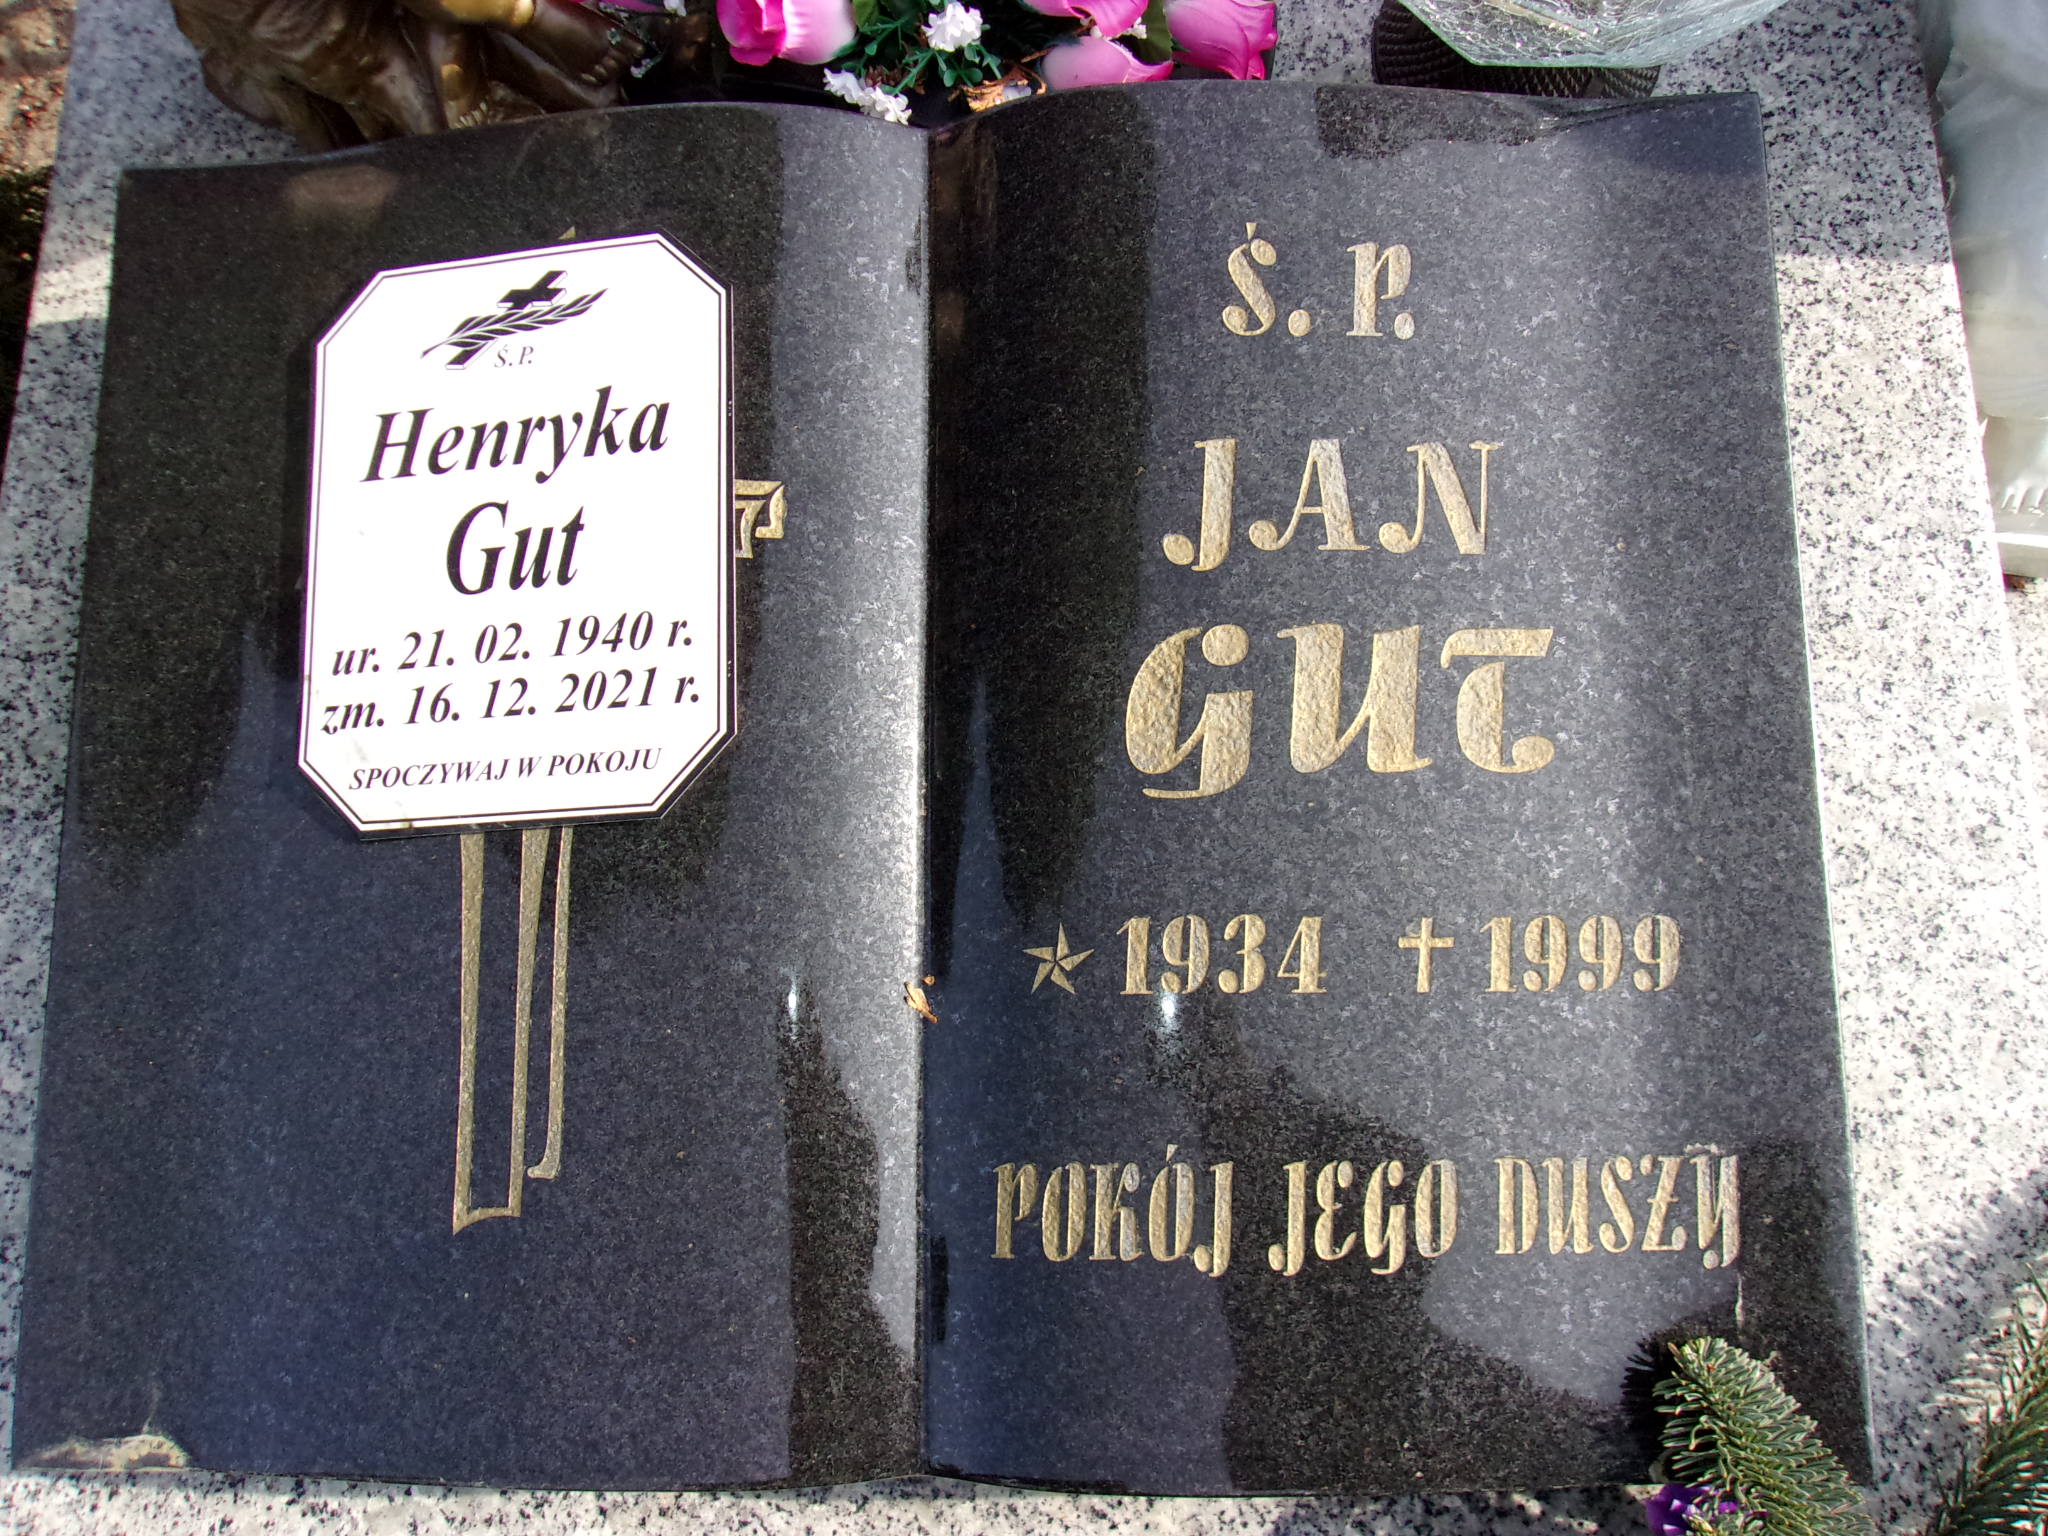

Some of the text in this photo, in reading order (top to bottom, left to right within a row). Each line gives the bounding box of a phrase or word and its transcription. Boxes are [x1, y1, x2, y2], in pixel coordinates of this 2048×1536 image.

[1222, 222, 1311, 337] Ś.
[517, 345, 534, 366] P.
[359, 385, 671, 484] Henryka
[446, 500, 584, 595] Gut
[1162, 438, 1503, 571] JAN
[332, 610, 693, 676] ur. 21. 02. 1940 r.
[320, 667, 700, 735] zm. 16. 12. 2021 r.
[1125, 623, 1555, 800] GUT
[348, 747, 663, 791] SPOCZYWAJ W POKOJU
[1116, 913, 1682, 995] 1934 1999
[990, 1143, 1742, 1277] POKÓJ JEGO DUSZY
